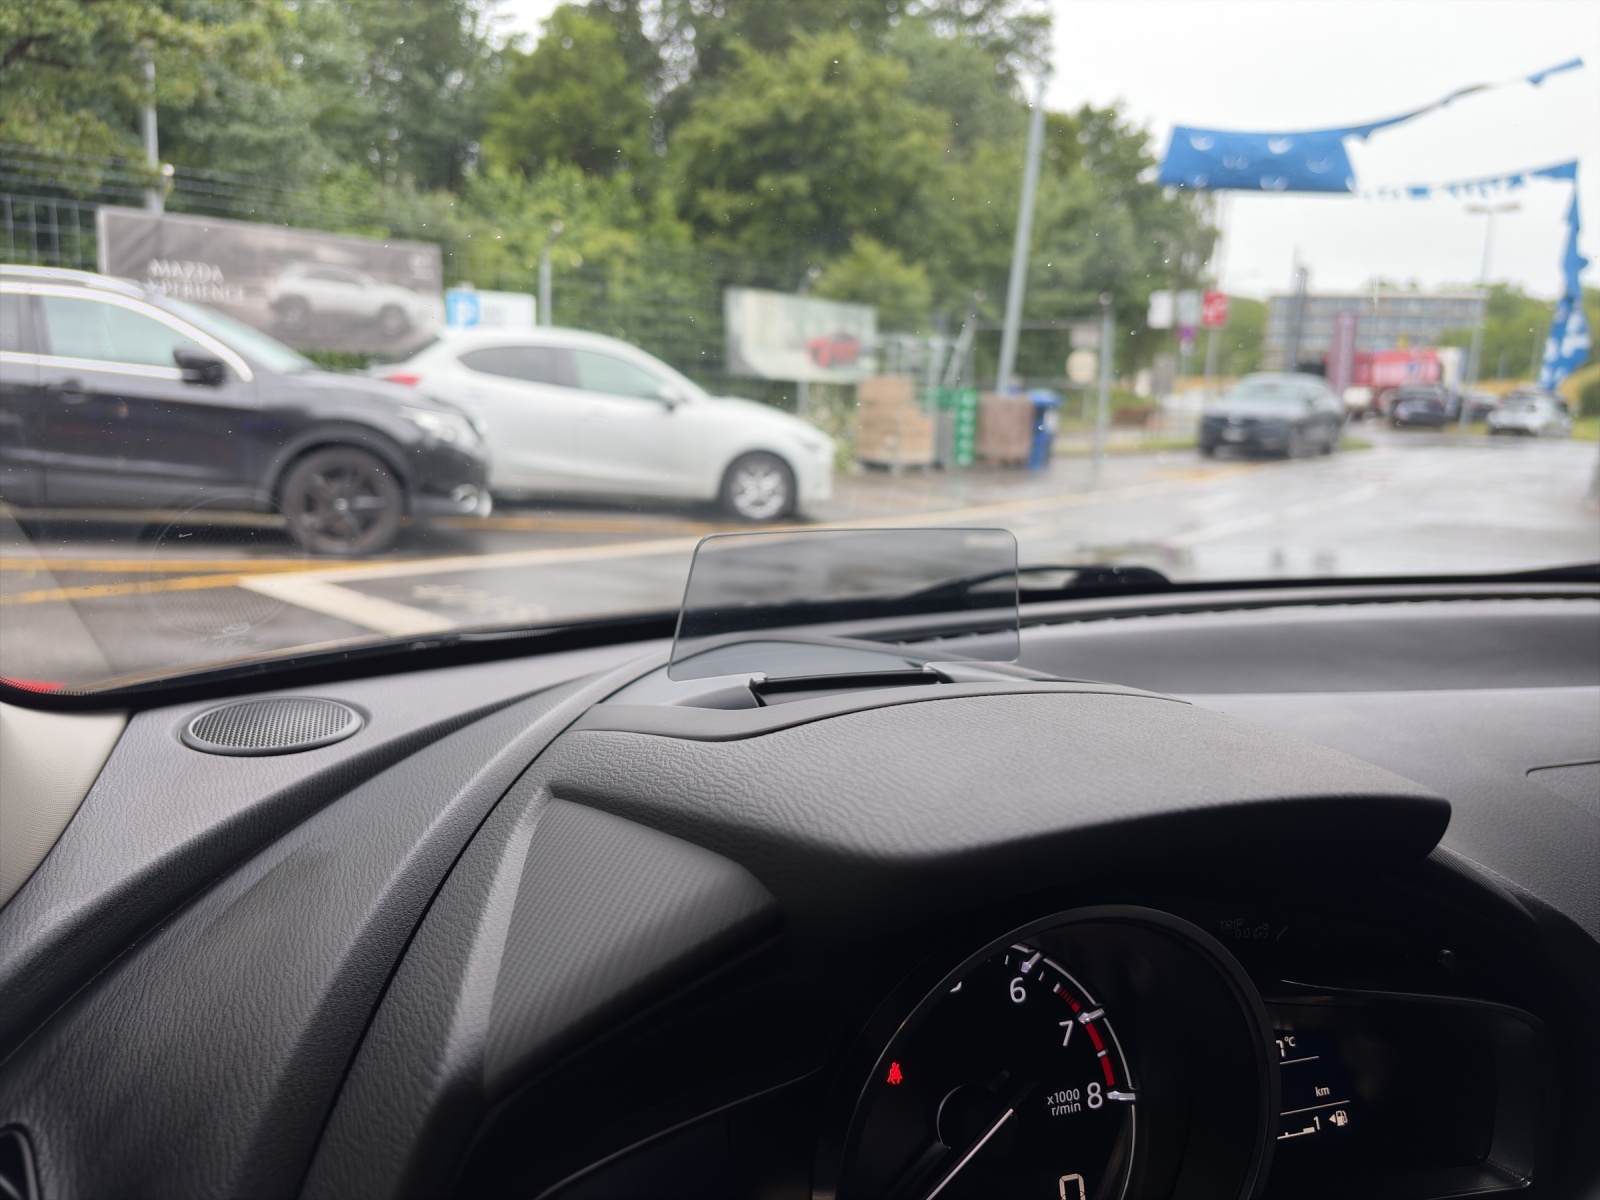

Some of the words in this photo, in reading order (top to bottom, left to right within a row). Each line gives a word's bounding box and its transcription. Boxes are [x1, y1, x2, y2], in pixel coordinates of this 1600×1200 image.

[147, 258, 225, 283] MAZDA
[144, 277, 244, 304] XPERIENCE
[1218, 918, 1244, 931] TRIP
[1009, 976, 1027, 1004] 6
[1058, 1019, 1074, 1047] 7
[1046, 1088, 1081, 1106] x1000
[1086, 1081, 1104, 1109] 8
[1314, 1086, 1331, 1097] km
[1050, 1101, 1082, 1117] r/min
[1313, 1116, 1321, 1131] 1
